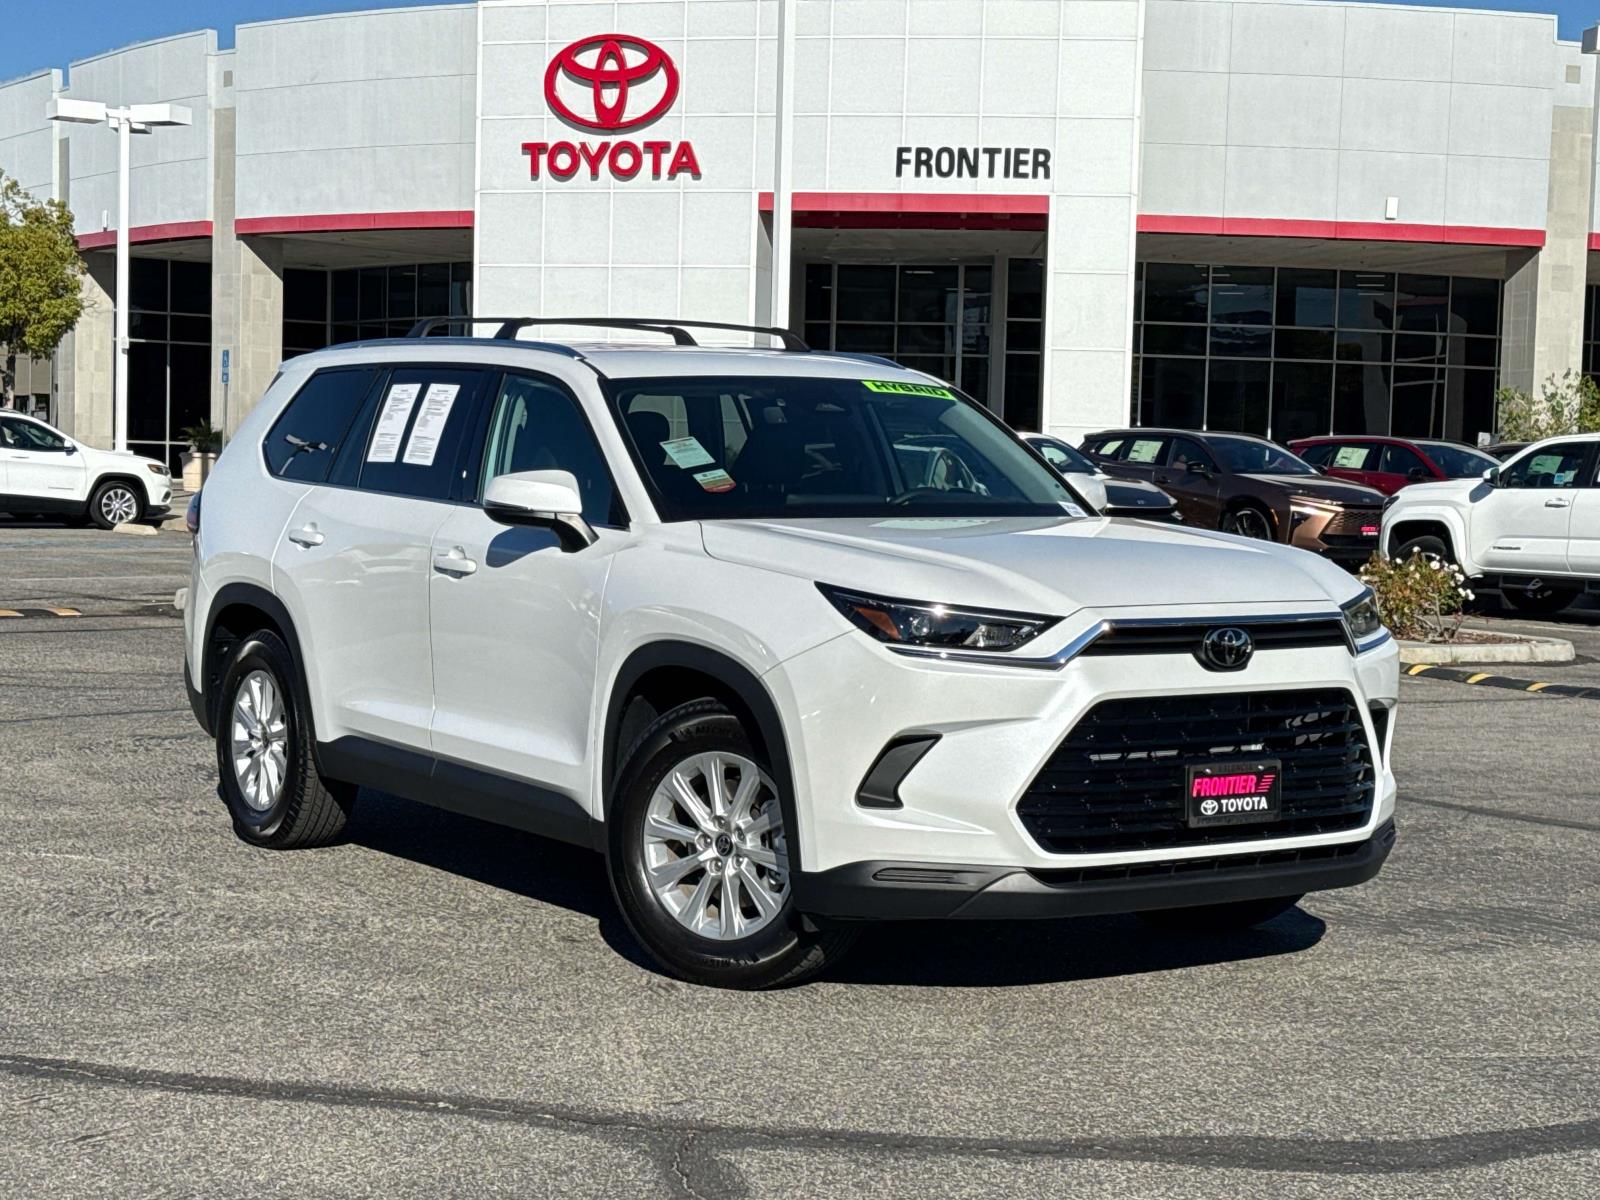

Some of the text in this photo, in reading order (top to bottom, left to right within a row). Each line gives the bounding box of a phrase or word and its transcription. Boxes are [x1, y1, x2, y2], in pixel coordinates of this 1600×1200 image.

[521, 140, 701, 180] TOYOTA
[895, 146, 1051, 180] FRONTIER
[871, 381, 949, 397] HYBRID
[1192, 774, 1257, 798] FRONTIER
[1221, 796, 1268, 813] TOYOTA
